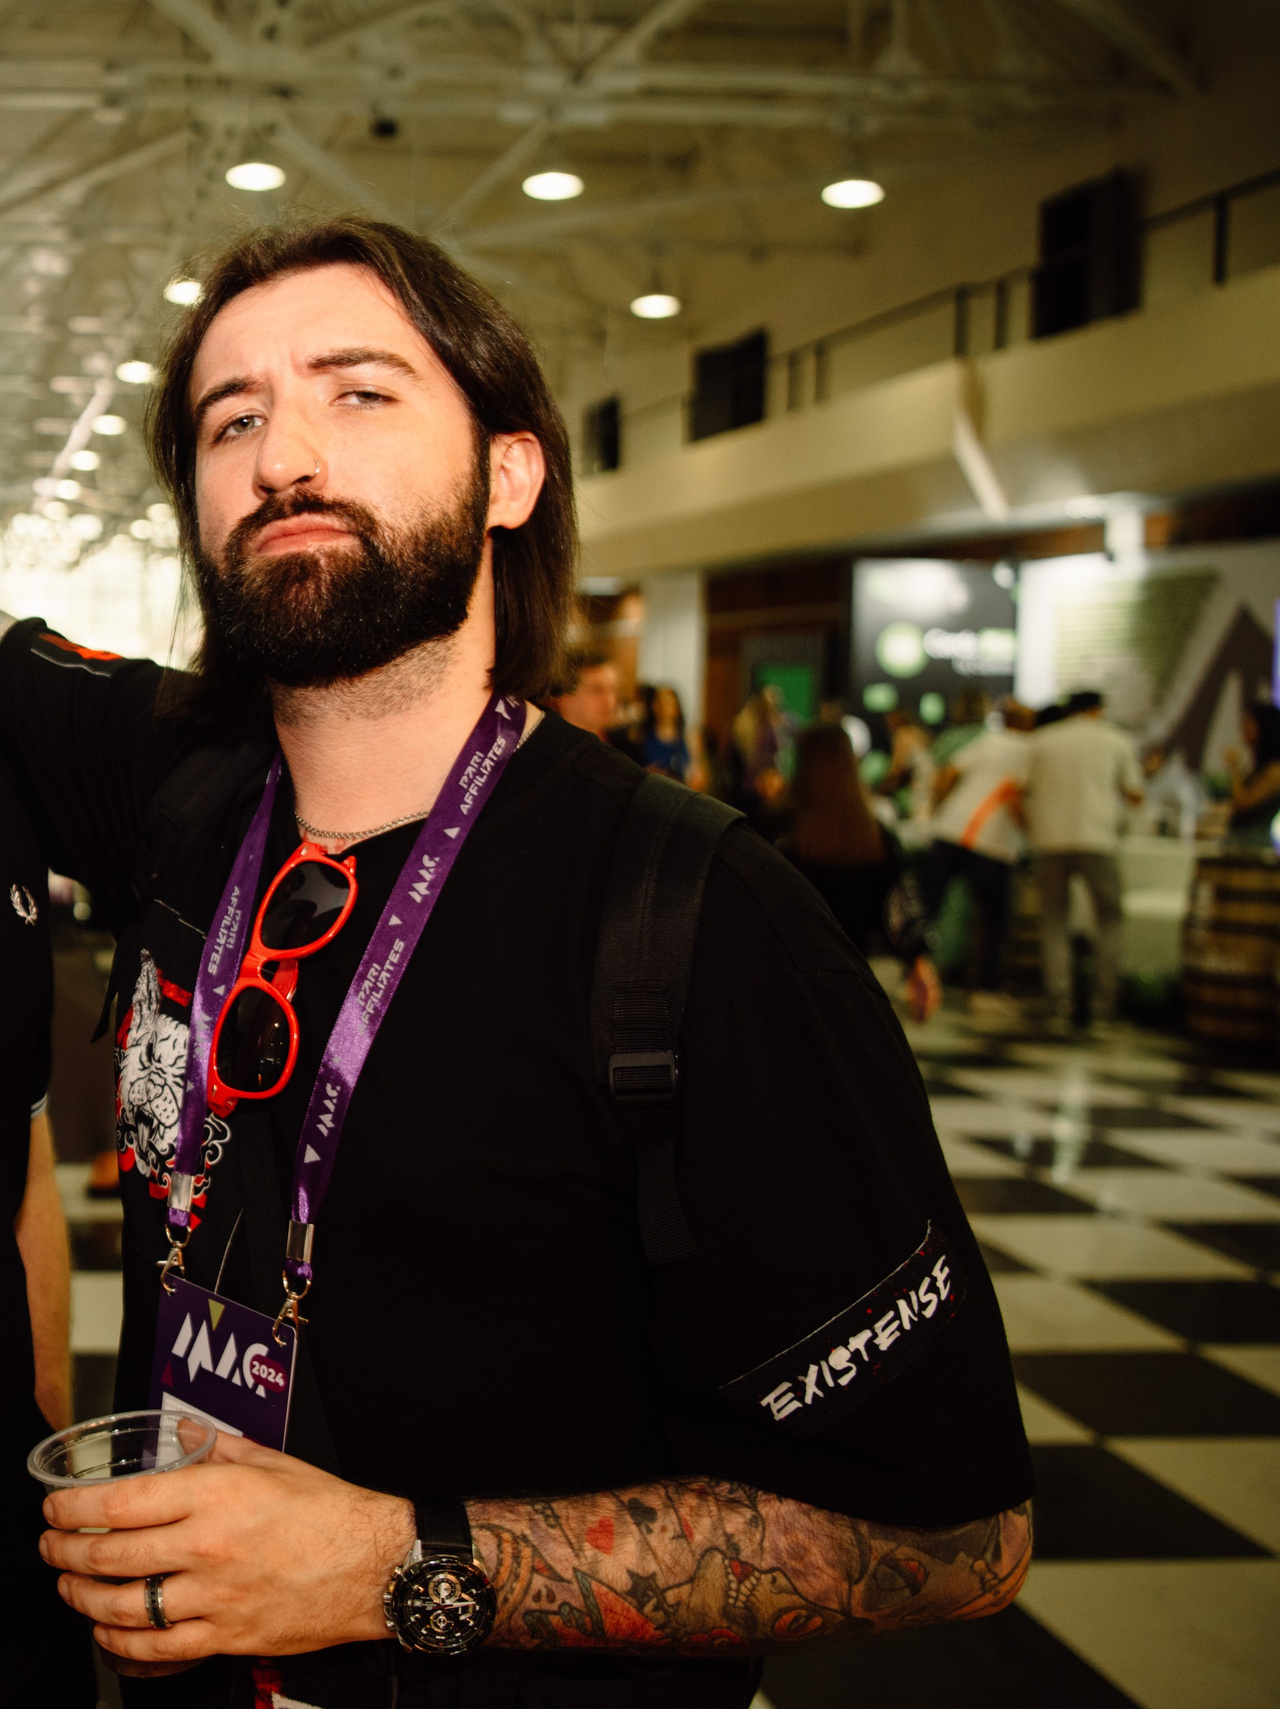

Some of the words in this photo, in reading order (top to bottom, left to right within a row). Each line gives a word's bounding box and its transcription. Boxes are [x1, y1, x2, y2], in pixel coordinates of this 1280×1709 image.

[458, 750, 485, 789] PARI
[459, 735, 505, 815] AFFILIATES
[207, 885, 240, 976] AFFILIATES
[251, 1360, 285, 1388] 2024
[760, 1254, 951, 1421] EXISTENSE
